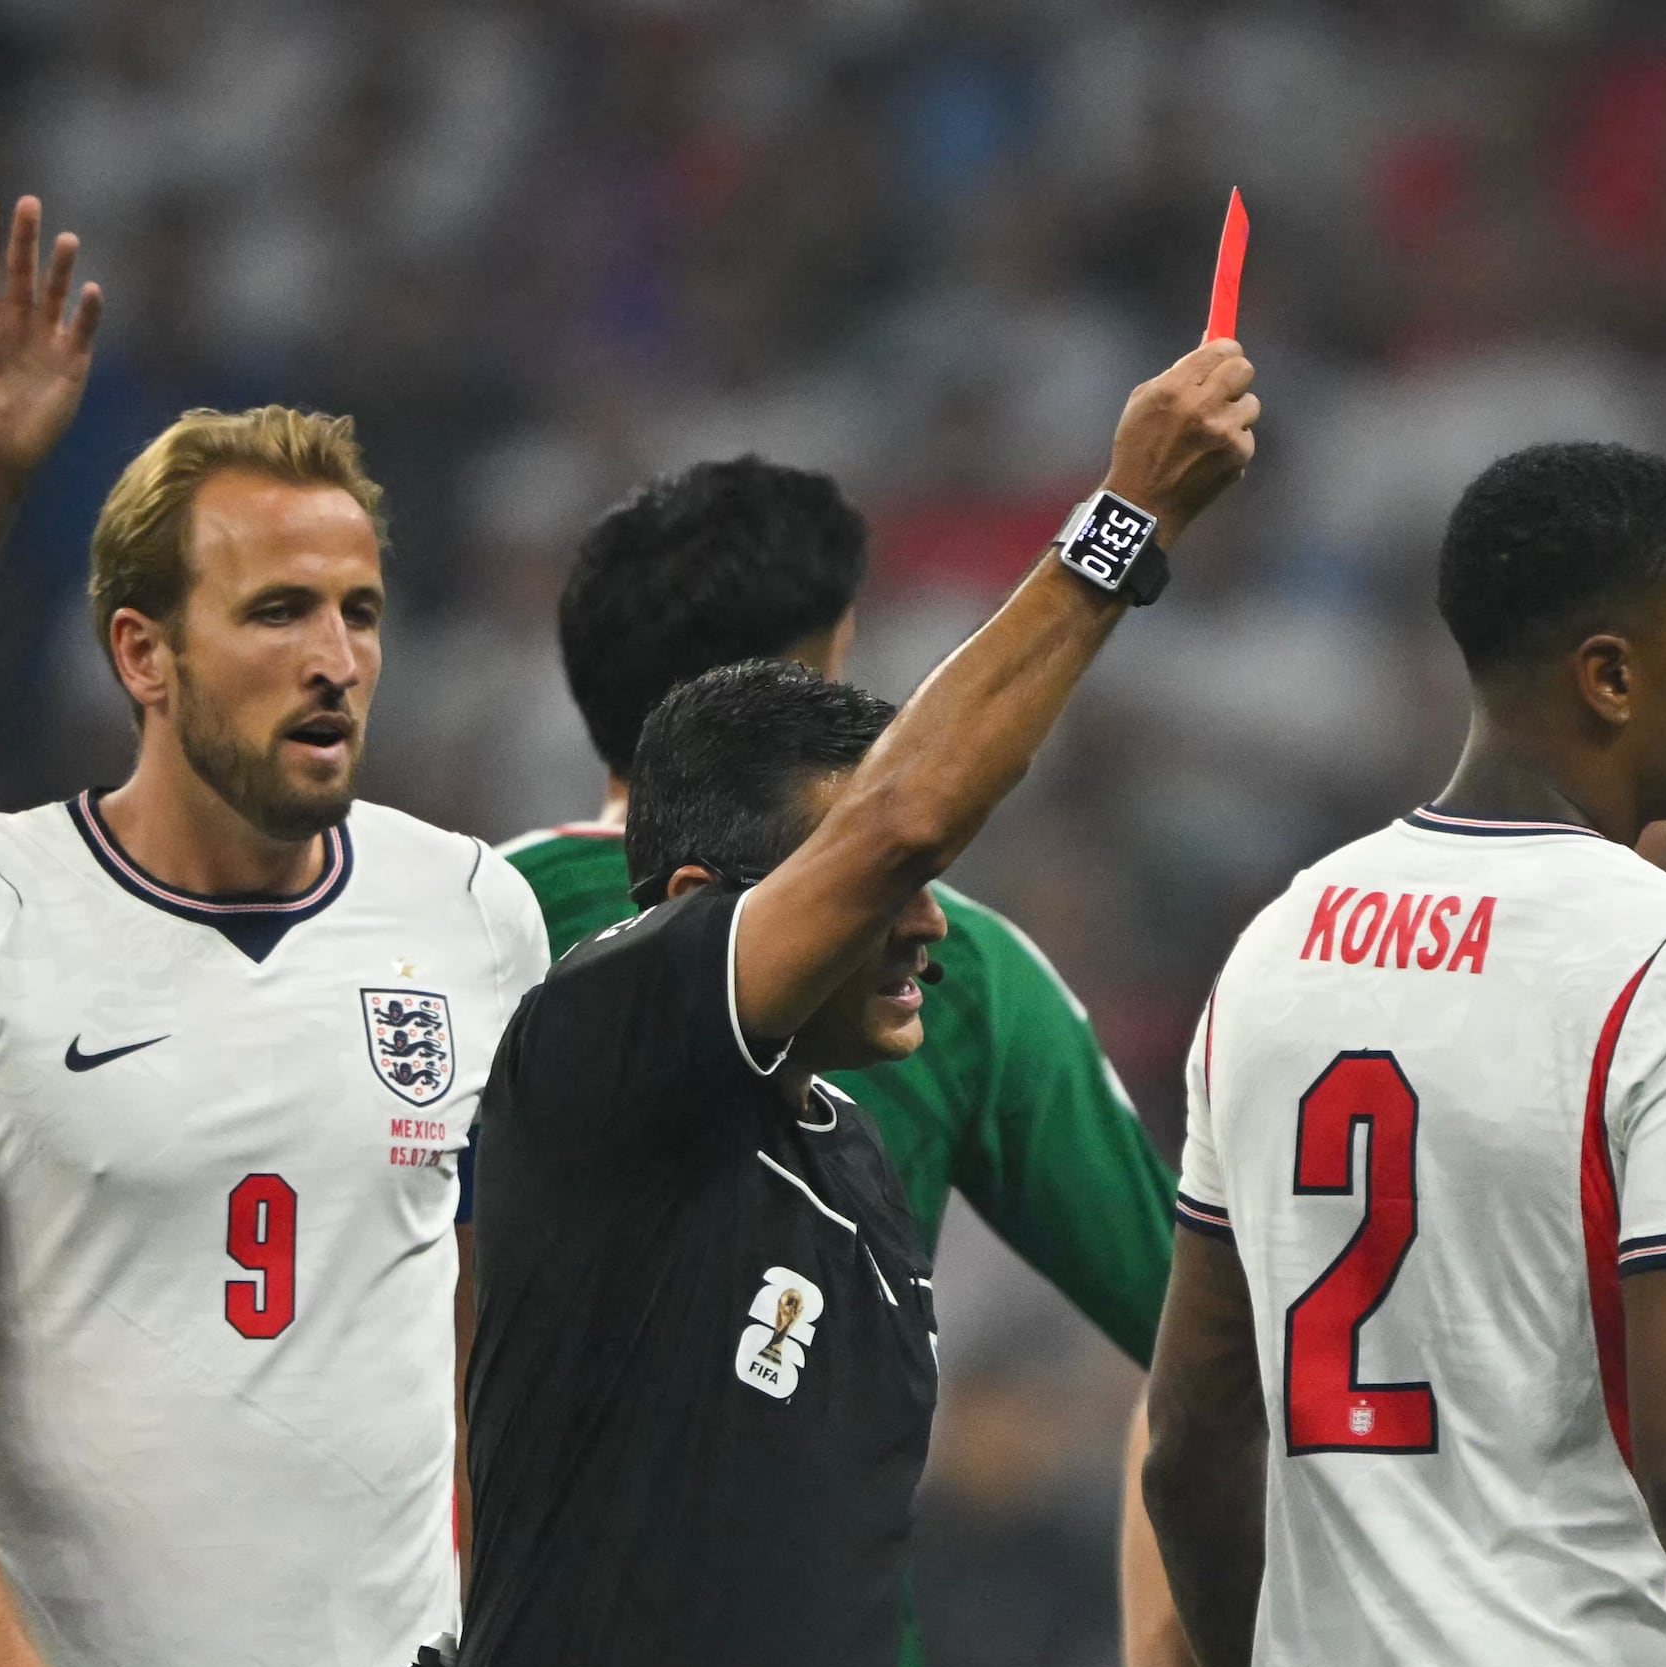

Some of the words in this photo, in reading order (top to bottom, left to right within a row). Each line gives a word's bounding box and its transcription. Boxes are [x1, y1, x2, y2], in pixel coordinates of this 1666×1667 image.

[1081, 509, 1141, 579] 53:10
[1300, 885, 1497, 974] KONSA
[391, 1118, 446, 1141] MEXICO
[225, 1173, 298, 1340] 9
[1285, 1049, 1439, 1457] 2
[748, 1361, 780, 1385] FIFA
